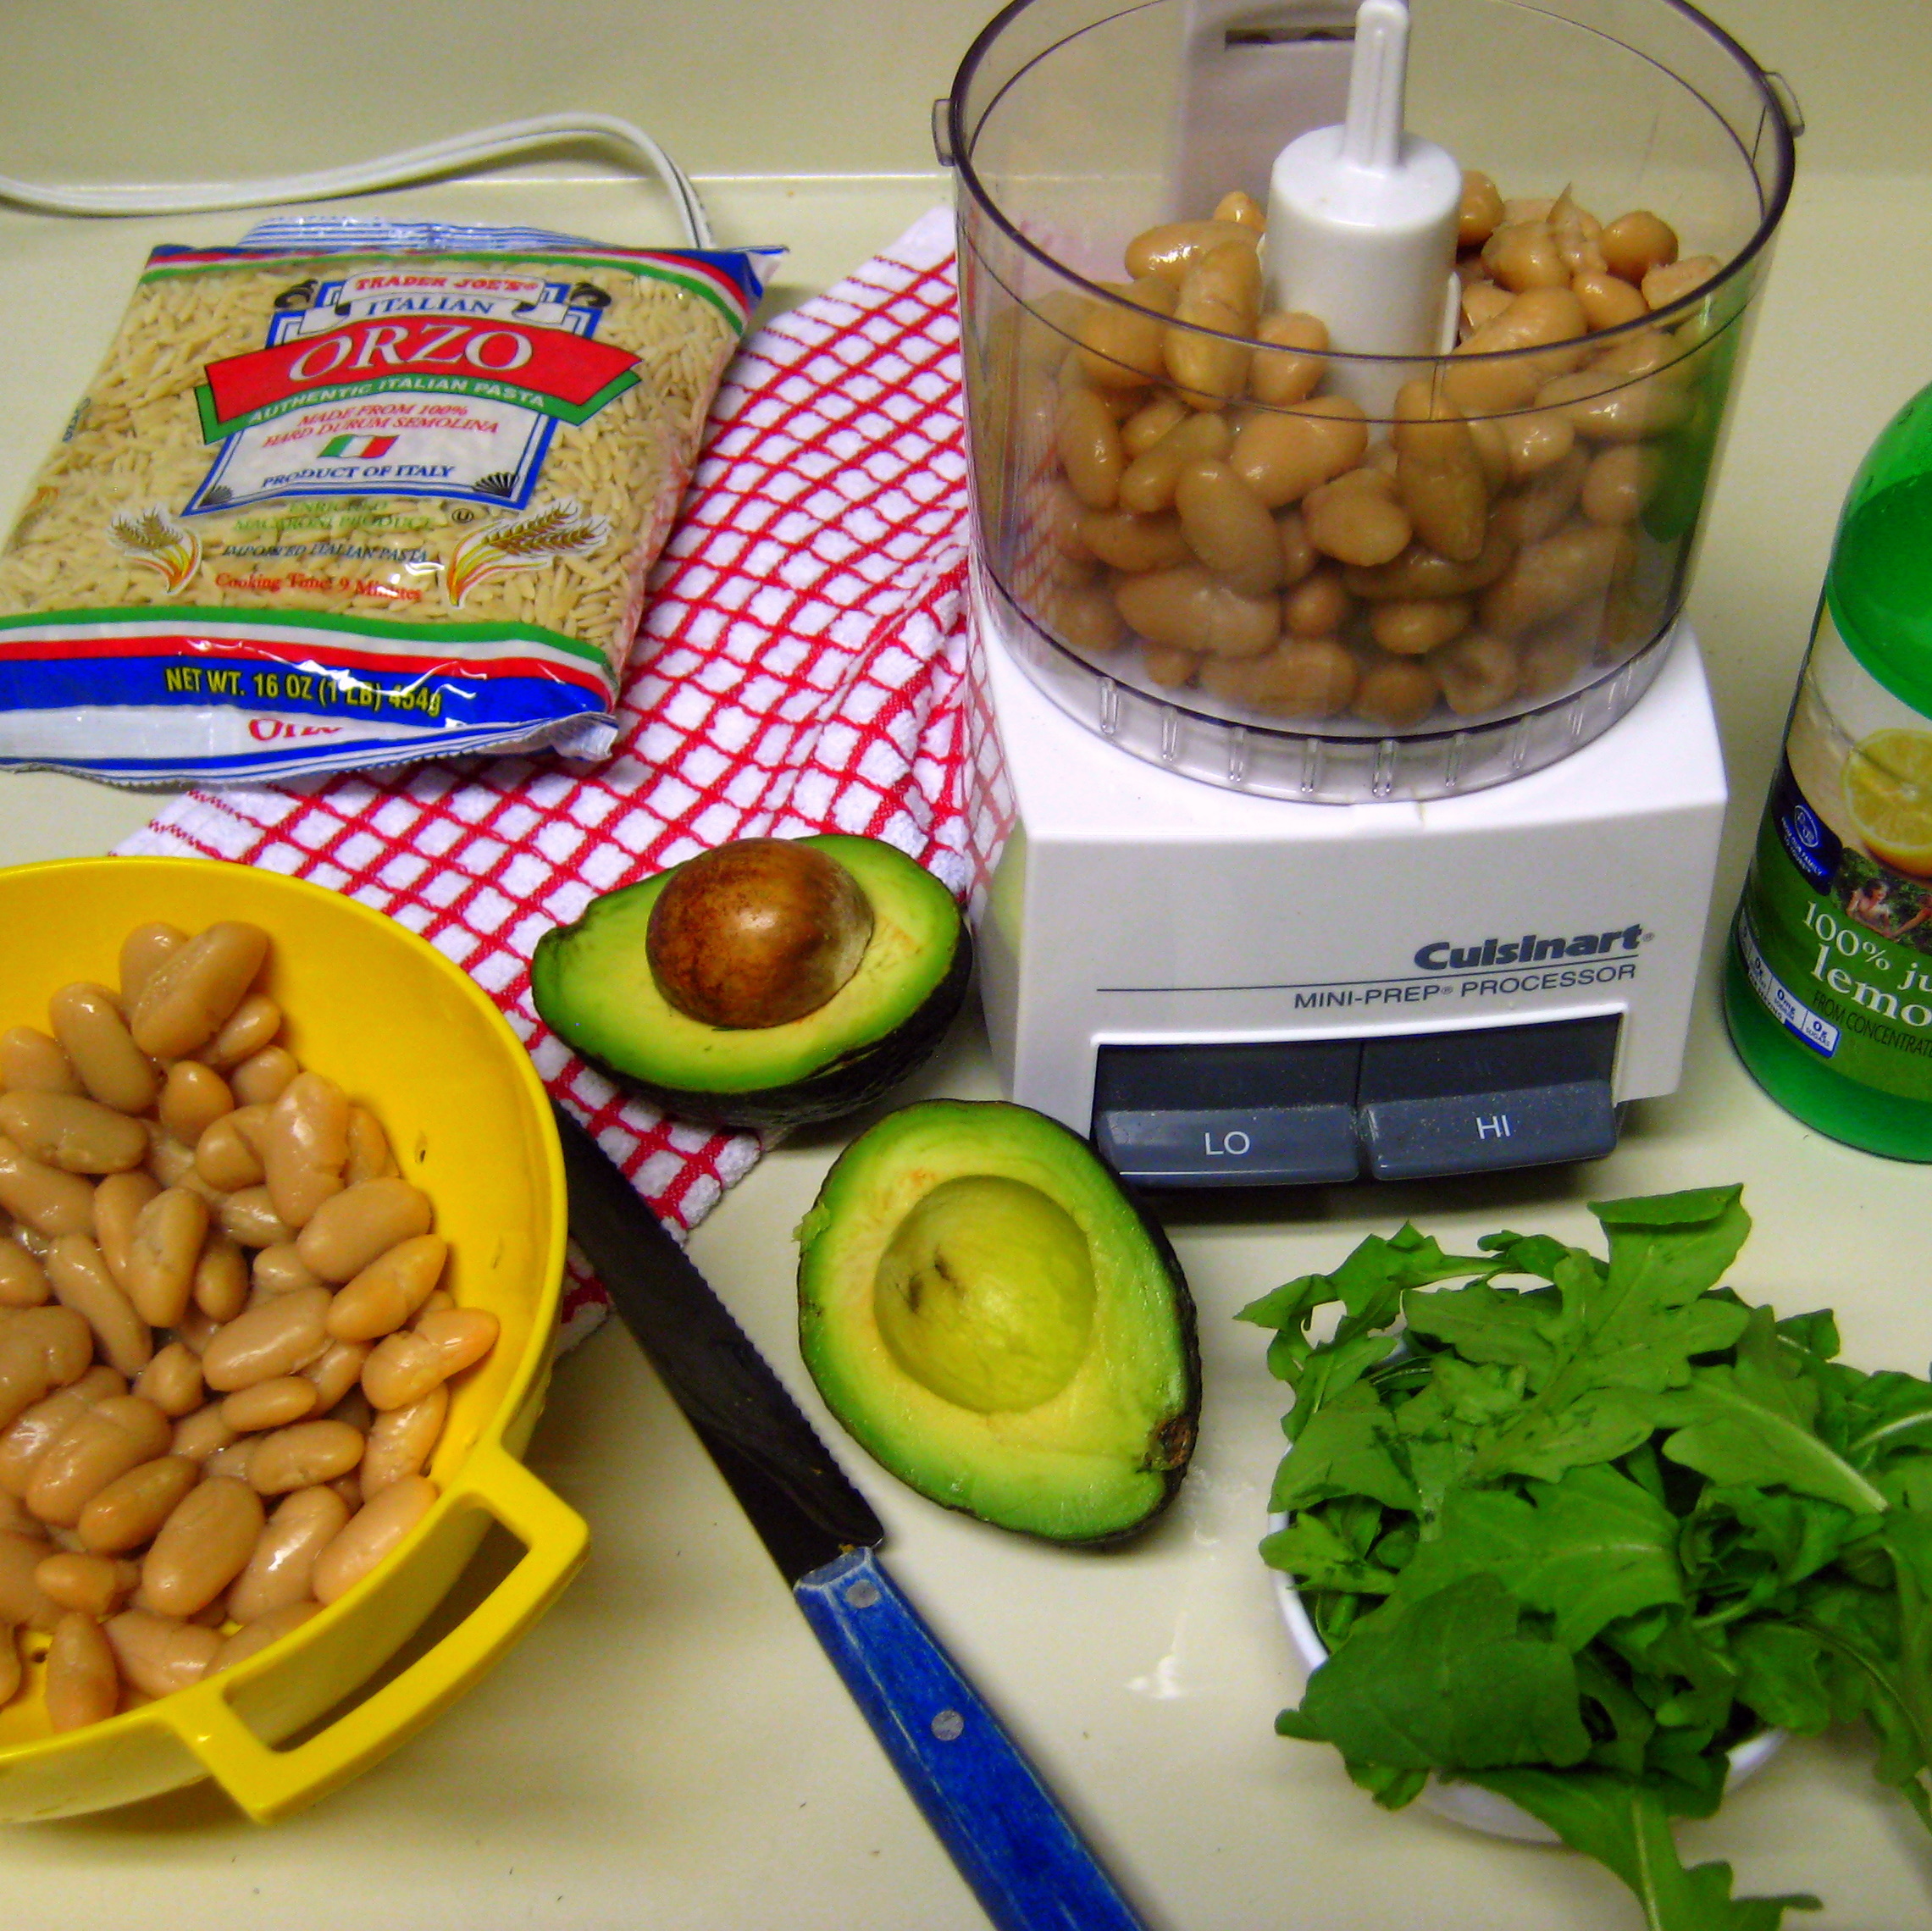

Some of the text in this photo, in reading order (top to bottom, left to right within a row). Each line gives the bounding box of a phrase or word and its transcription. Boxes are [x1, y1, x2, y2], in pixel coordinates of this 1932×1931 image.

[356, 276, 447, 290] TRADER
[367, 296, 494, 316] ITALIAN
[288, 324, 534, 383] ORZO
[249, 377, 545, 423] AUTHENTIC ITALIAN PASTA
[297, 403, 469, 426] MADE FROM 100%
[262, 417, 500, 447] HARD DURUM SEMOLINA
[261, 465, 456, 489] PRODUCT OF ITALY
[215, 572, 282, 593] Cooking
[340, 578, 350, 591] 9
[166, 667, 202, 692] NET
[207, 667, 246, 696] WT.
[254, 673, 280, 699] 16
[285, 673, 313, 700] OZ
[1414, 923, 1643, 971] Cuisinart
[1802, 900, 1891, 971] 100%
[1460, 963, 1636, 998] PROCESSOR
[1813, 990, 1847, 1026] FROM
[1477, 1115, 1511, 1140] HI
[1204, 1131, 1251, 1156] LO
